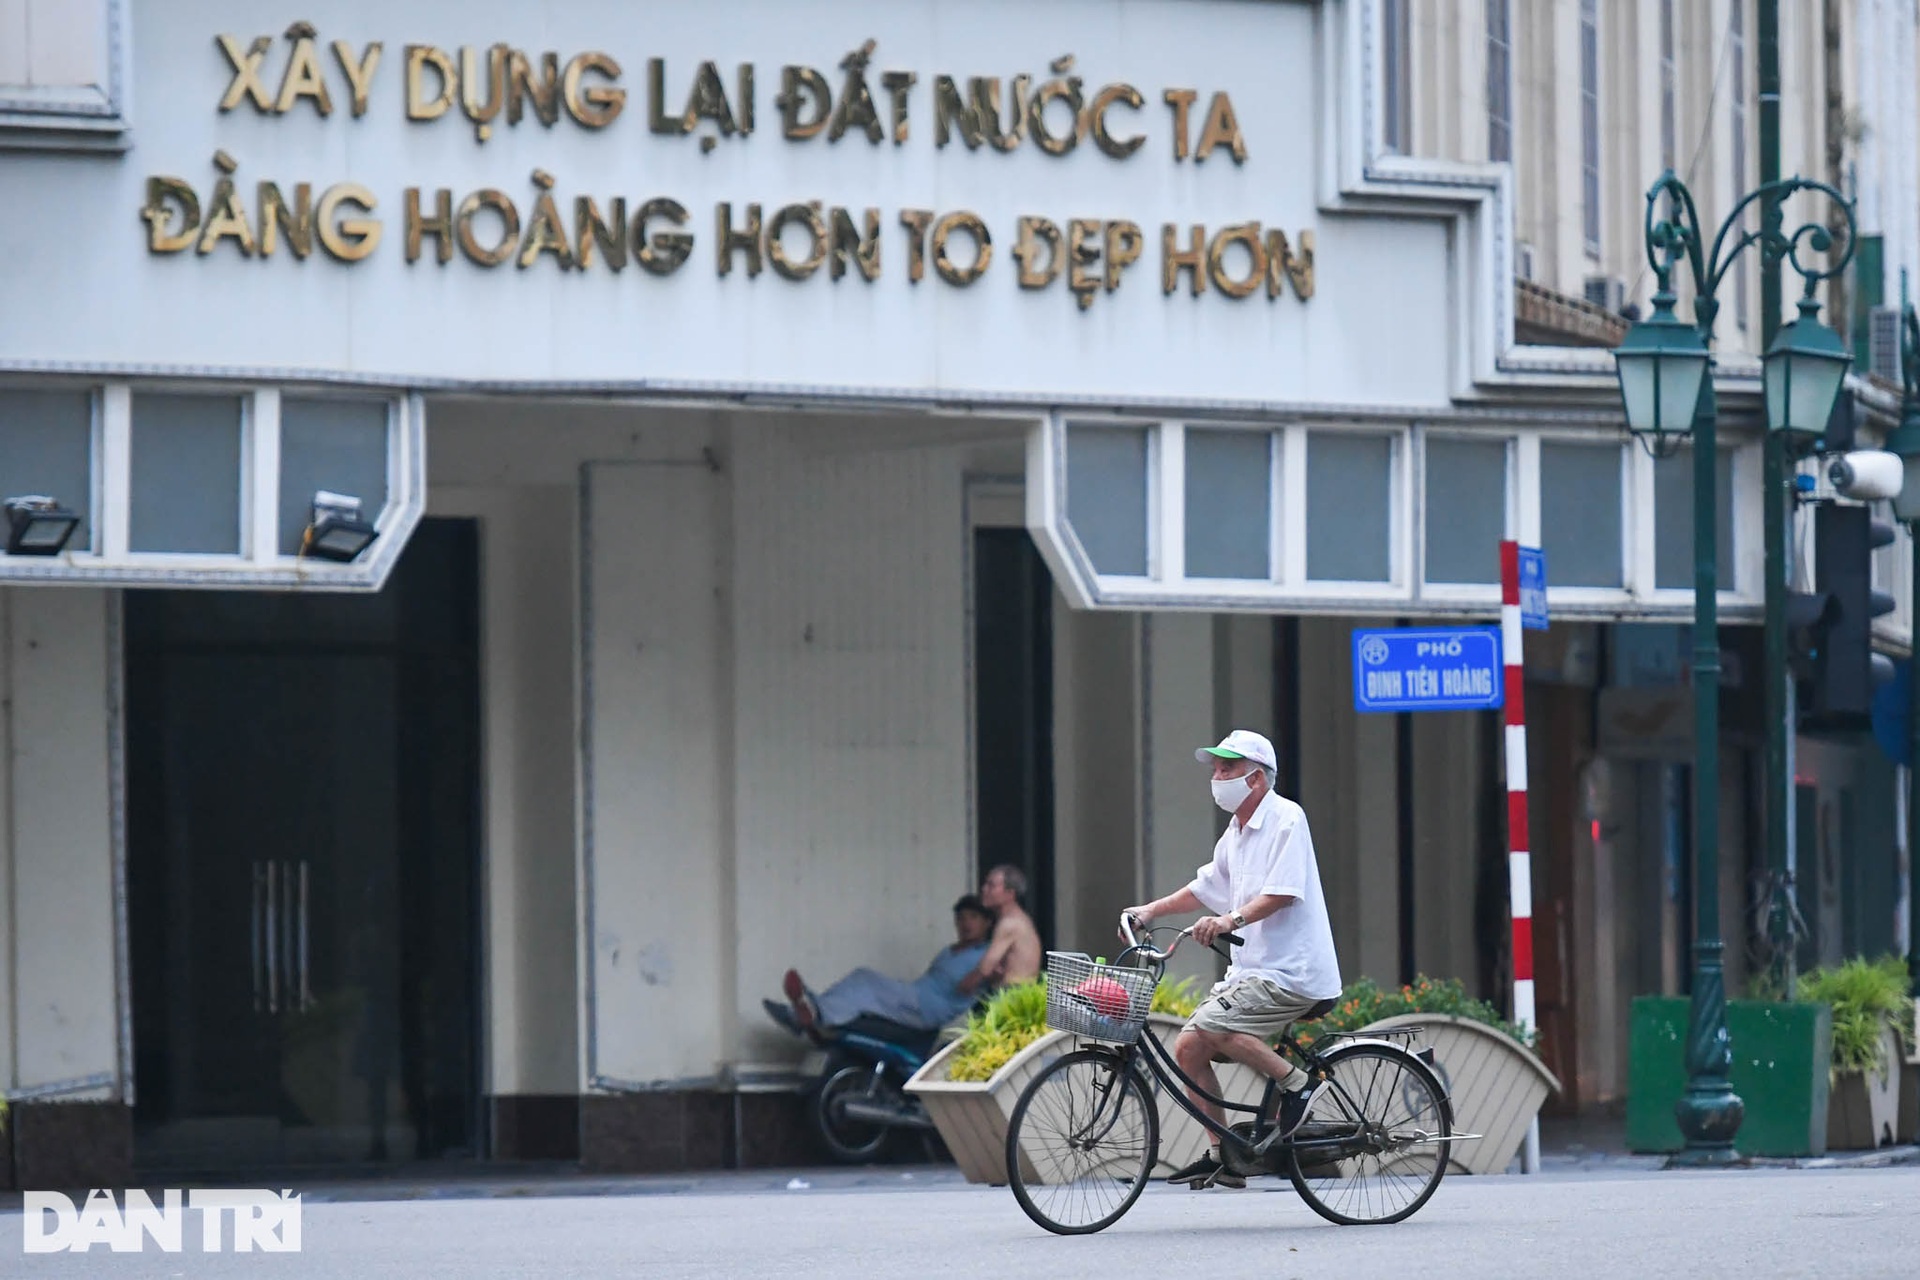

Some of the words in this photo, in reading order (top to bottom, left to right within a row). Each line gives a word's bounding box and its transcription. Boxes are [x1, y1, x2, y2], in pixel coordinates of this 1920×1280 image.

[215, 22, 383, 117] XÂY
[648, 57, 755, 154] LẠI
[775, 39, 916, 146] ĐẤT
[934, 54, 1147, 160] NƯỚC
[1163, 88, 1249, 163] TA
[142, 150, 383, 261] ĐÀNG
[403, 168, 694, 276] HOÀNG
[715, 200, 882, 283] HƠN
[901, 208, 993, 288] TO
[1012, 215, 1143, 311] ĐẸP
[1160, 220, 1316, 303] HƠN
[1442, 662, 1492, 696] HOÀNG
